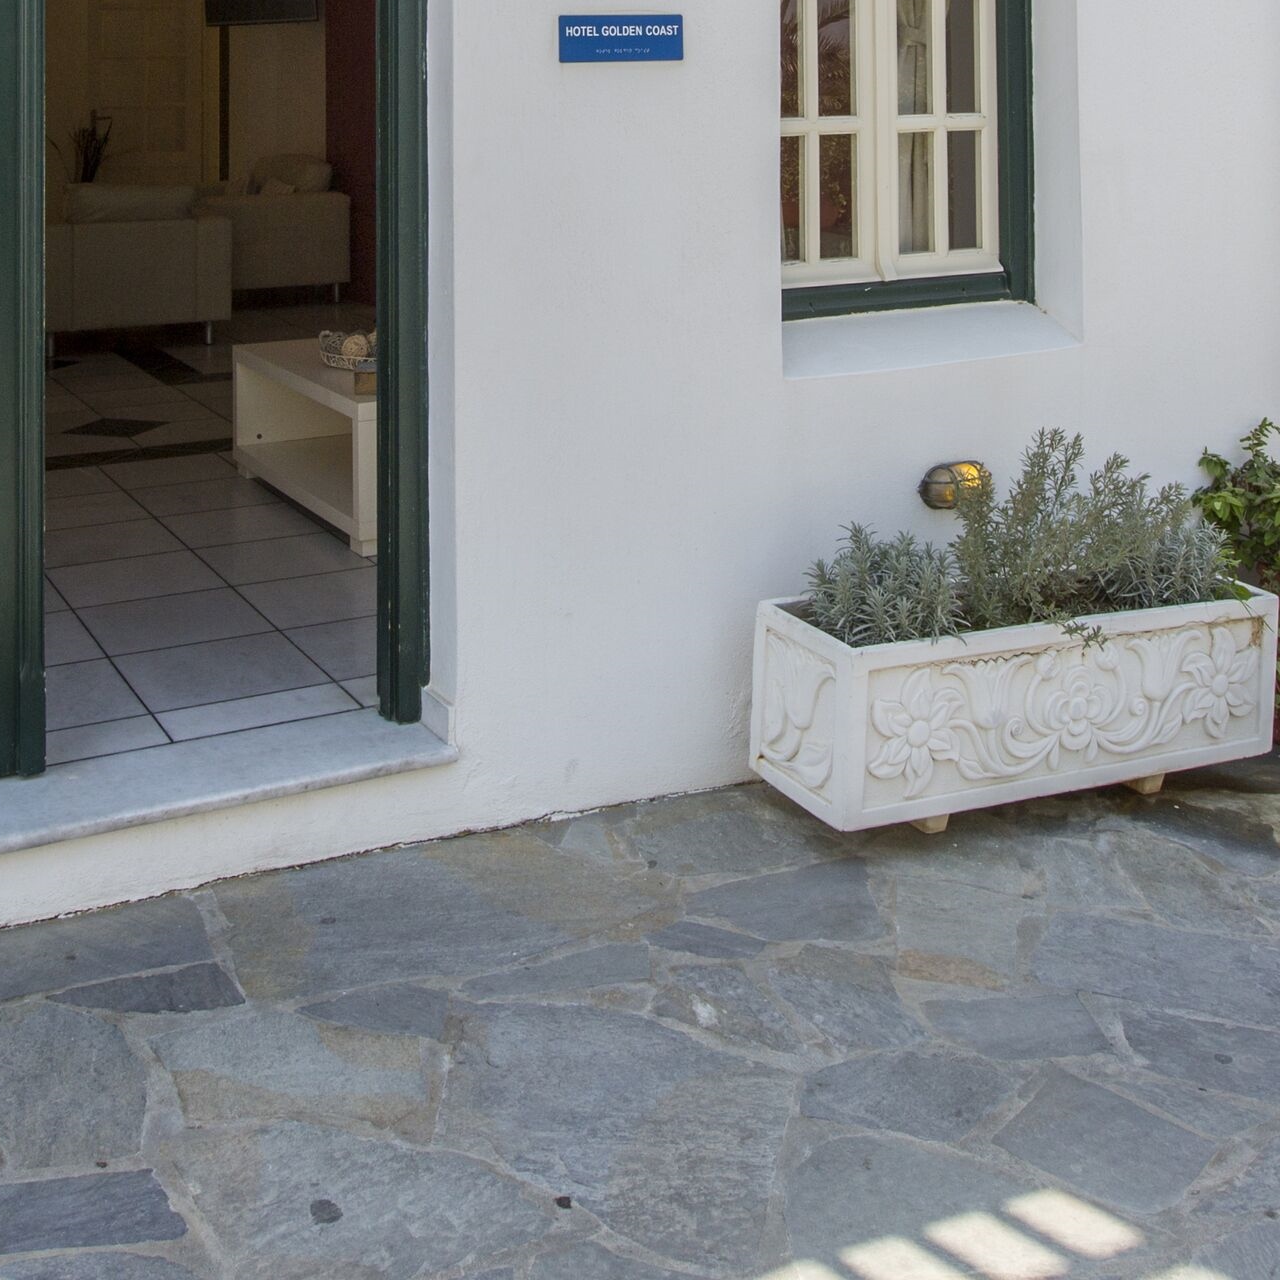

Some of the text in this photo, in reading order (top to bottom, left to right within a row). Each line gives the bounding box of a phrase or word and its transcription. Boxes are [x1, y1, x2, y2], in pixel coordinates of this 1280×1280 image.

[565, 25, 679, 37] HOTEL GOLDEN COAST
